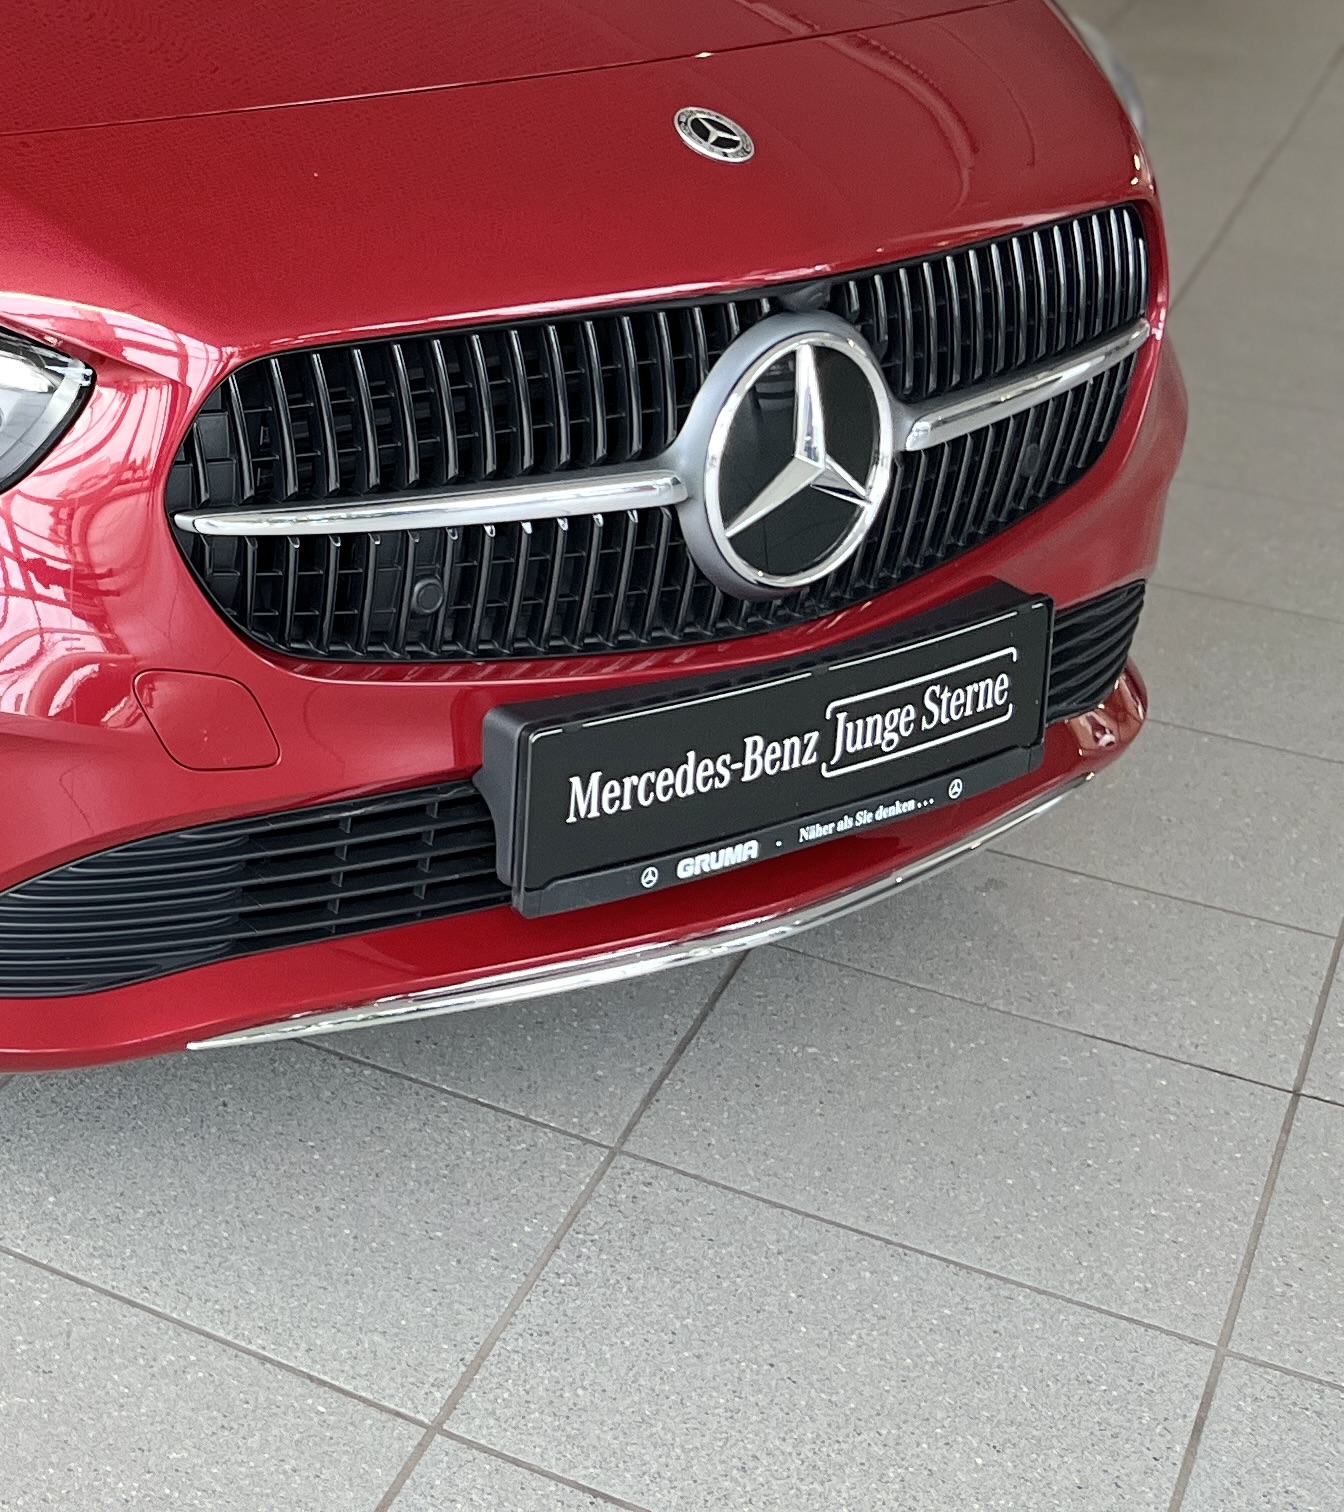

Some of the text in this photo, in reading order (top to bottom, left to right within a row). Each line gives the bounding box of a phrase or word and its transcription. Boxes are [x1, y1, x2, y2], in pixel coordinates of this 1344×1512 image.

[566, 672, 1010, 824] Mercedes-Benz Junge Sterne
[676, 839, 760, 880] GRUMA
[798, 822, 836, 843] Näher
[836, 814, 854, 833] als
[855, 809, 875, 827] Sie
